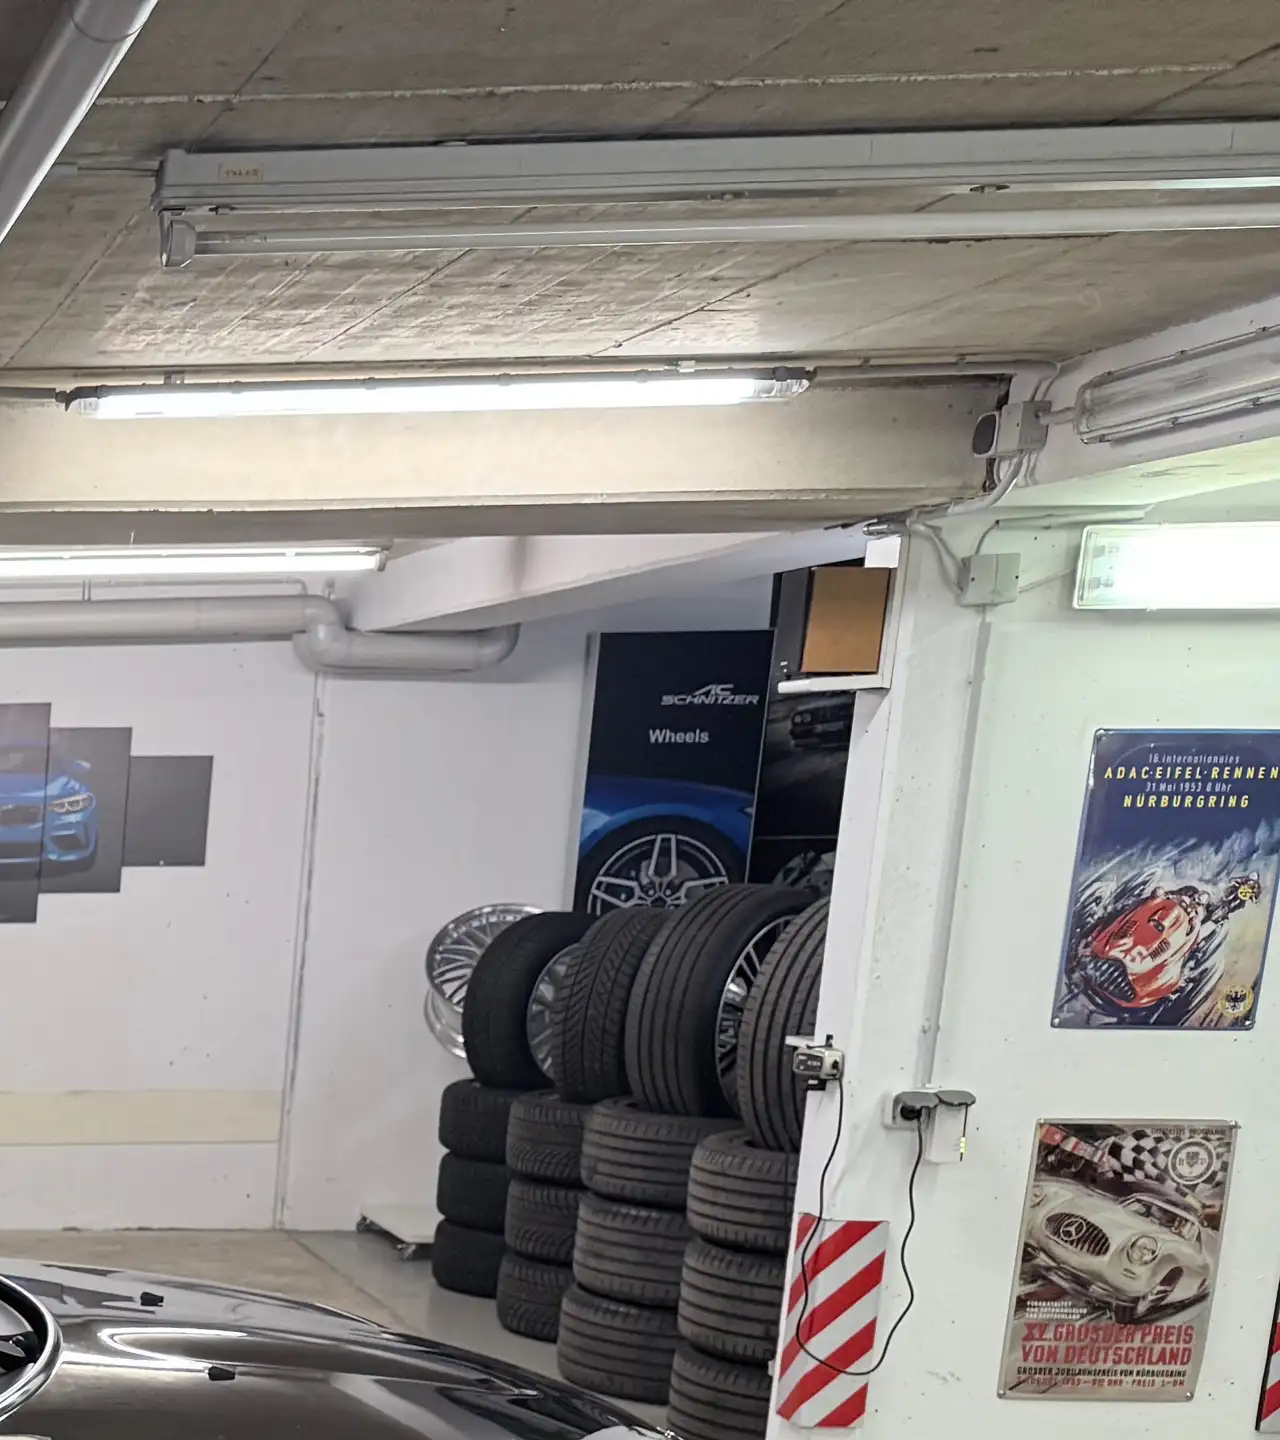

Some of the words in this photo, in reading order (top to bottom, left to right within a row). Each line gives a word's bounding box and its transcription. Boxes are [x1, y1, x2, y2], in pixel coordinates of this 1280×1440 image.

[661, 694, 759, 706] SCHNITZER
[649, 728, 709, 743] Wheels
[1214, 782, 1232, 792] Uhr
[1123, 793, 1249, 808] NÜRBURGRING
[1140, 1324, 1194, 1344] PREIS
[1022, 1344, 1058, 1363] VON
[1064, 1345, 1192, 1365] DEUTSCHLAND
